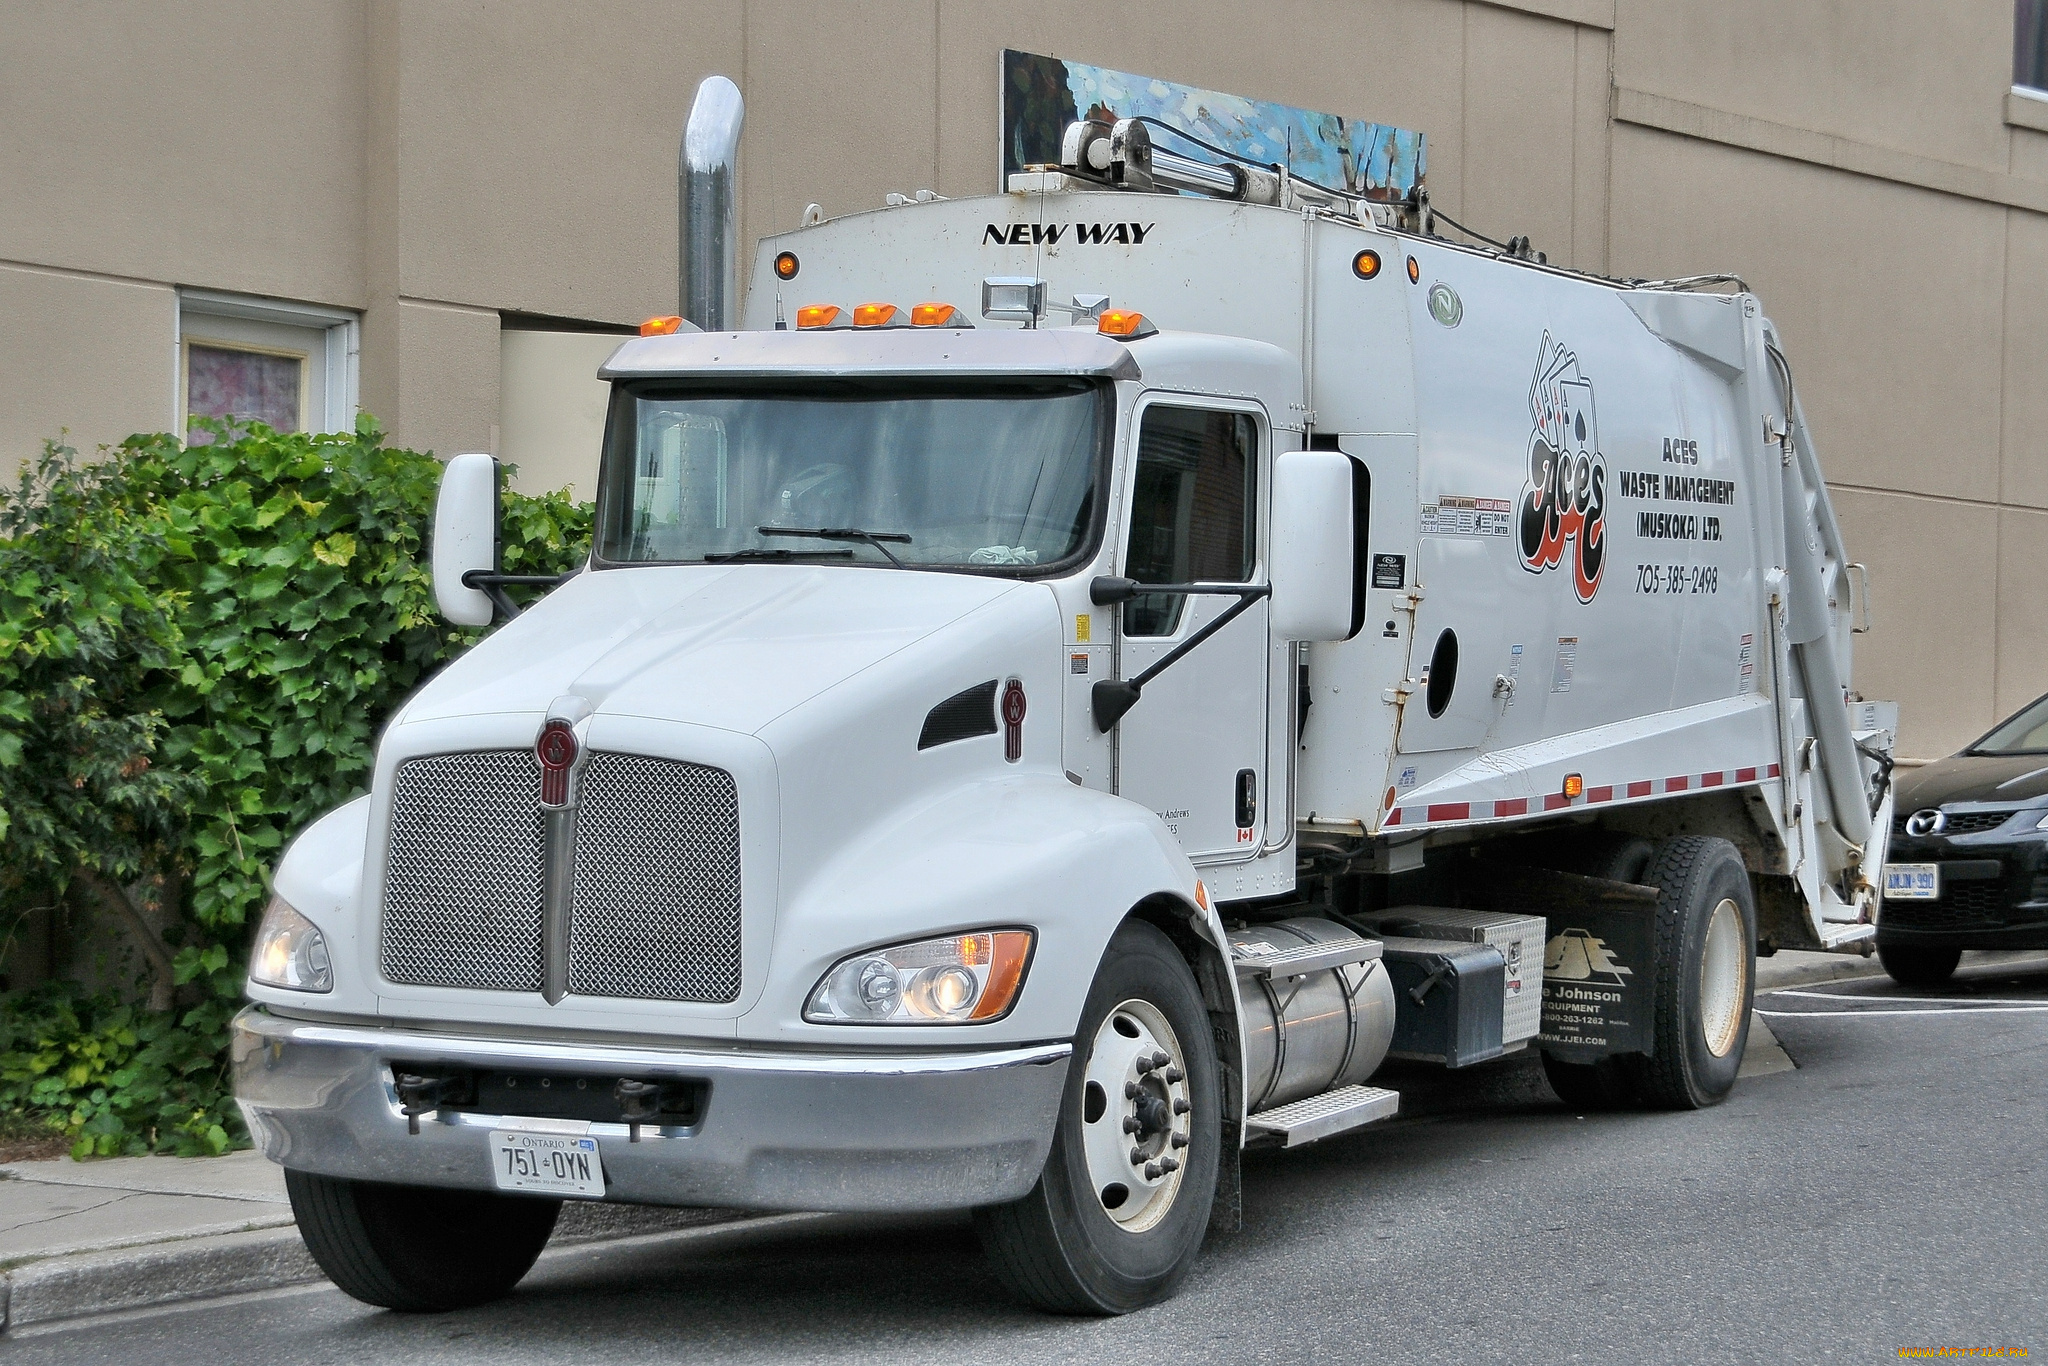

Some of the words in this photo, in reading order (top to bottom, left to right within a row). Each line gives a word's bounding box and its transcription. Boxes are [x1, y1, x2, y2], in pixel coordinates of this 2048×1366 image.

[982, 223, 1069, 245] NEW
[1075, 222, 1155, 245] WAY
[1662, 438, 1698, 465] ACES
[1620, 471, 1659, 499] WASTE
[1664, 475, 1735, 505] MANAGEMENT
[1637, 512, 1698, 540] (MUSKOKA)
[1702, 517, 1722, 541] LTD.
[1635, 565, 1718, 594] 705-385-2498
[1542, 1001, 1601, 1013] EQUIPMENT
[1555, 987, 1621, 1002] Johnson
[1542, 1013, 1604, 1025] -800-263-1262
[502, 1147, 540, 1177] 751
